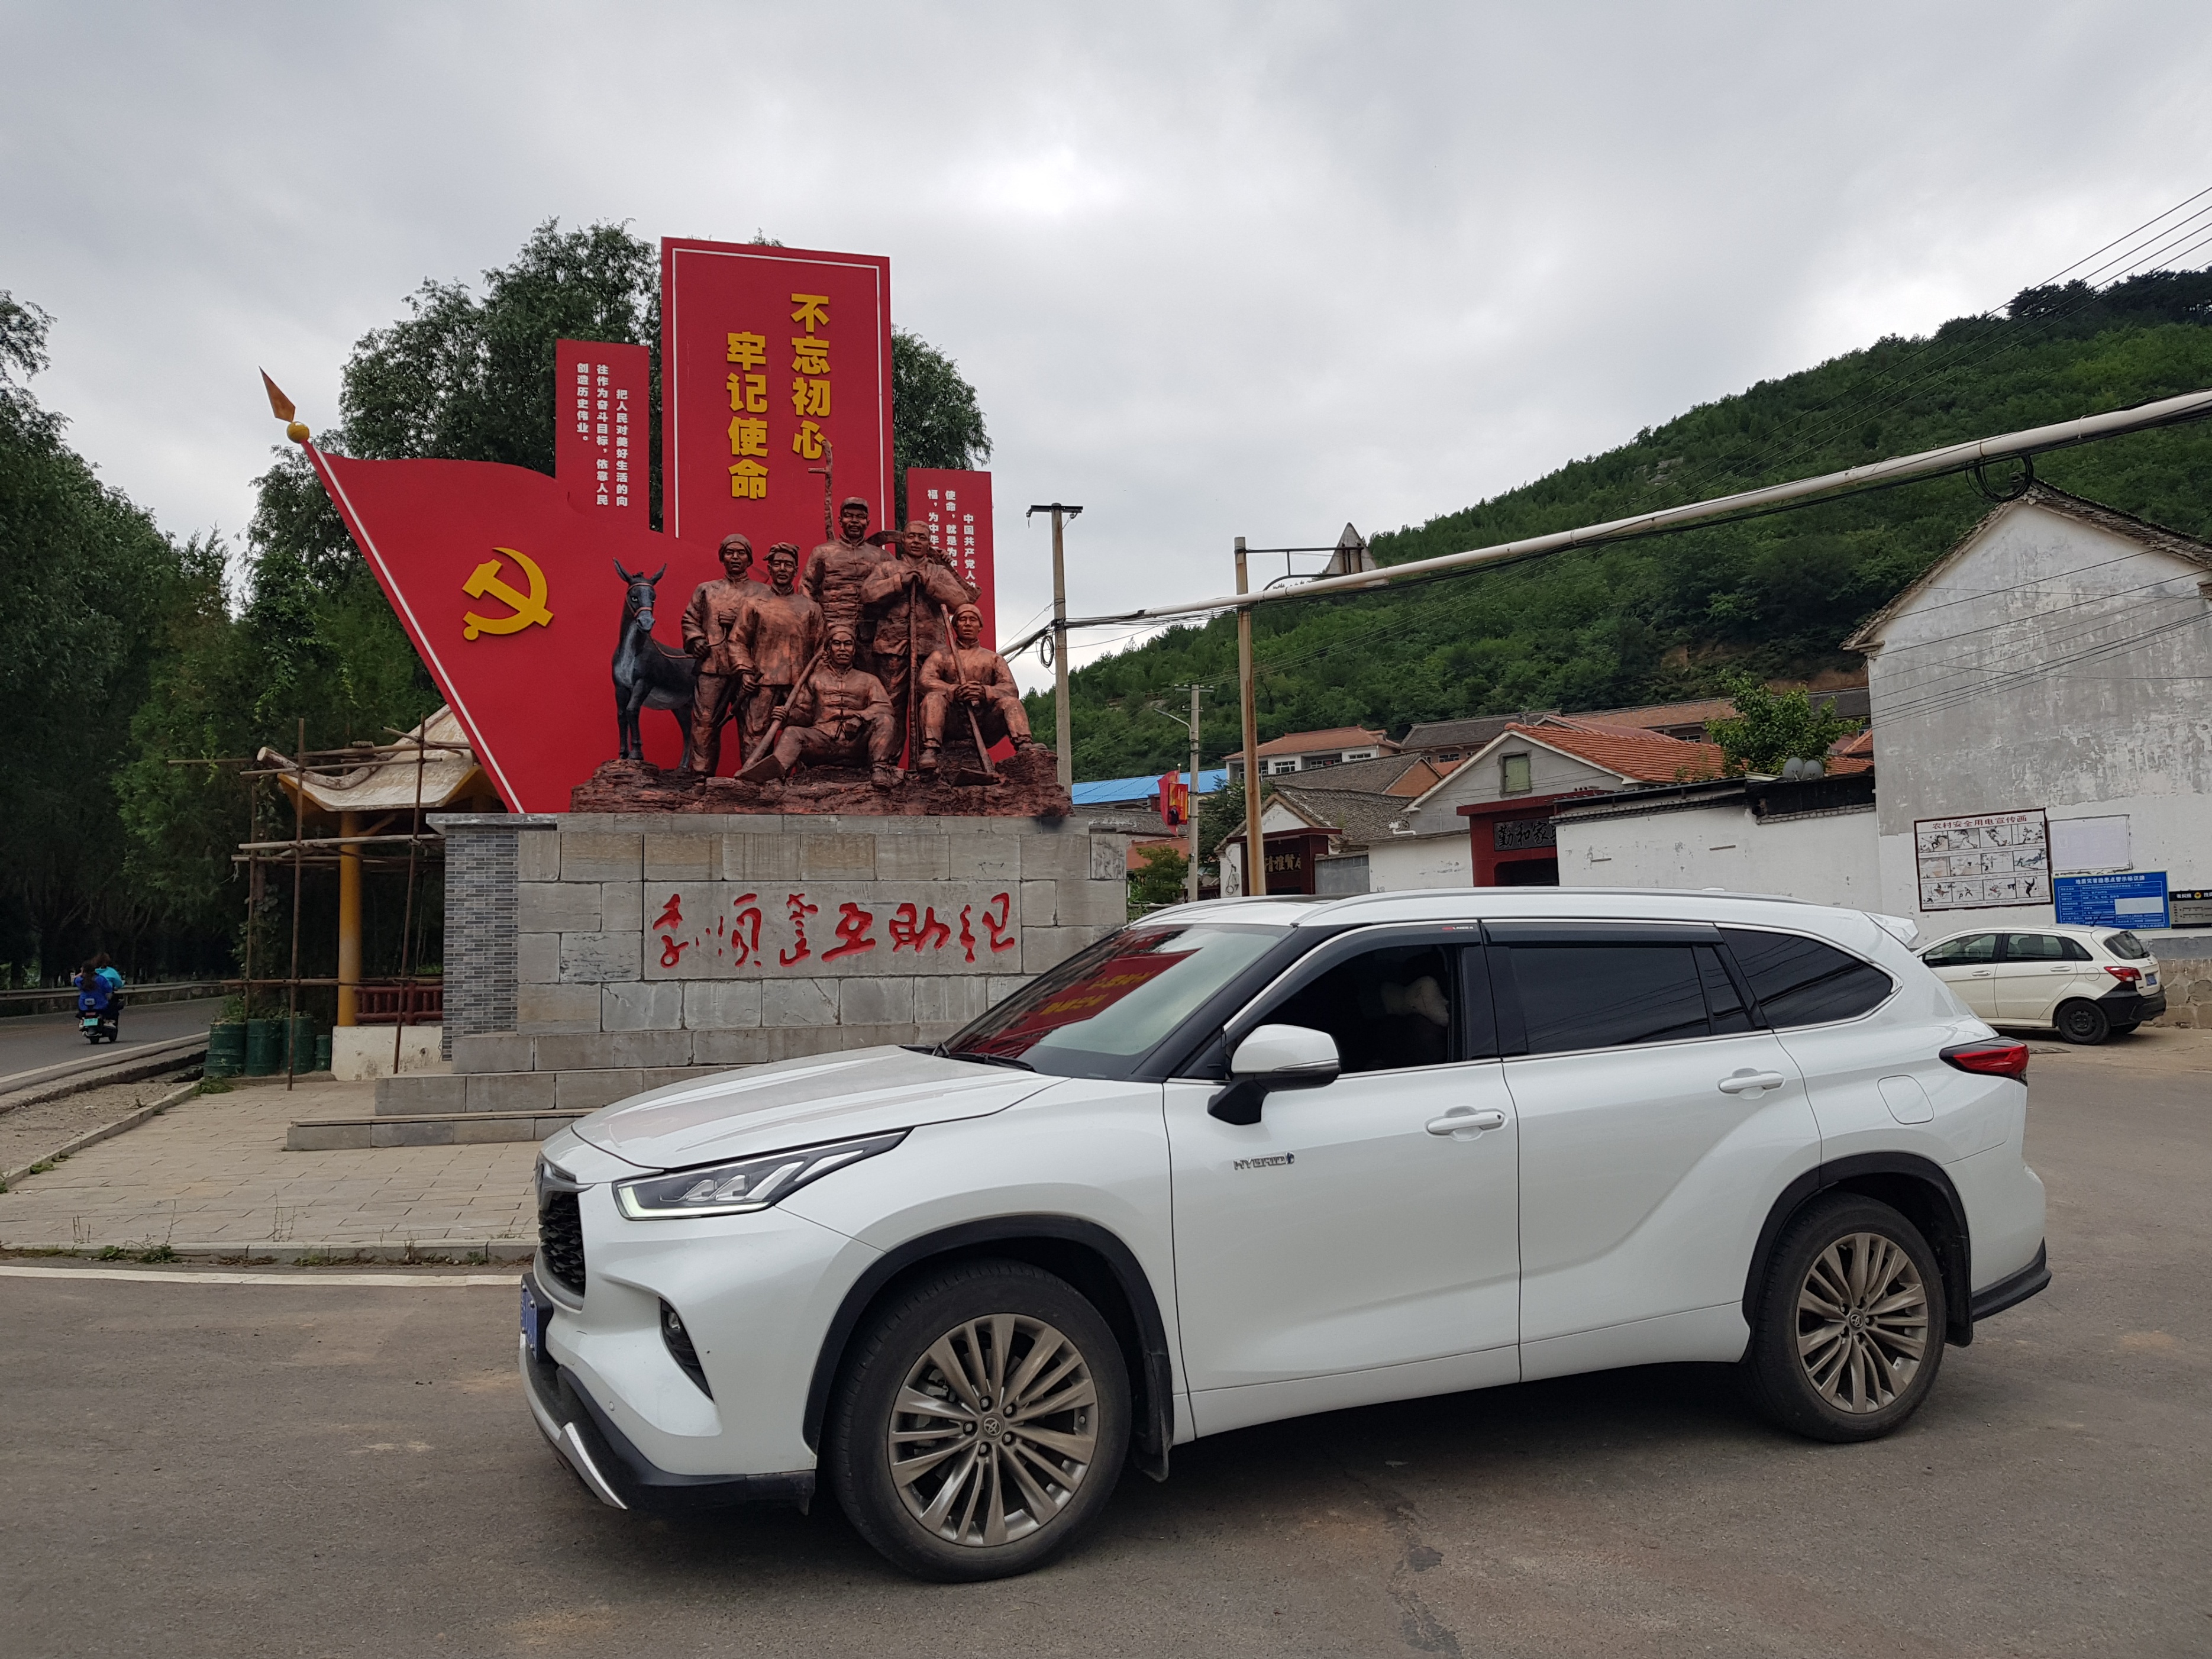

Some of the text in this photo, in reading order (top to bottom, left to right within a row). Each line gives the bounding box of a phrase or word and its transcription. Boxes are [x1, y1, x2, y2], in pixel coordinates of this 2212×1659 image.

[726, 331, 768, 499] 牢记使命
[790, 293, 831, 459] 不忘初心
[616, 389, 628, 506] 把人民对美好生活的向
[928, 489, 939, 550] 福，为中华
[1932, 815, 2027, 830] 农村安全用电宣传画
[1233, 1156, 1286, 1170] HYBRID
